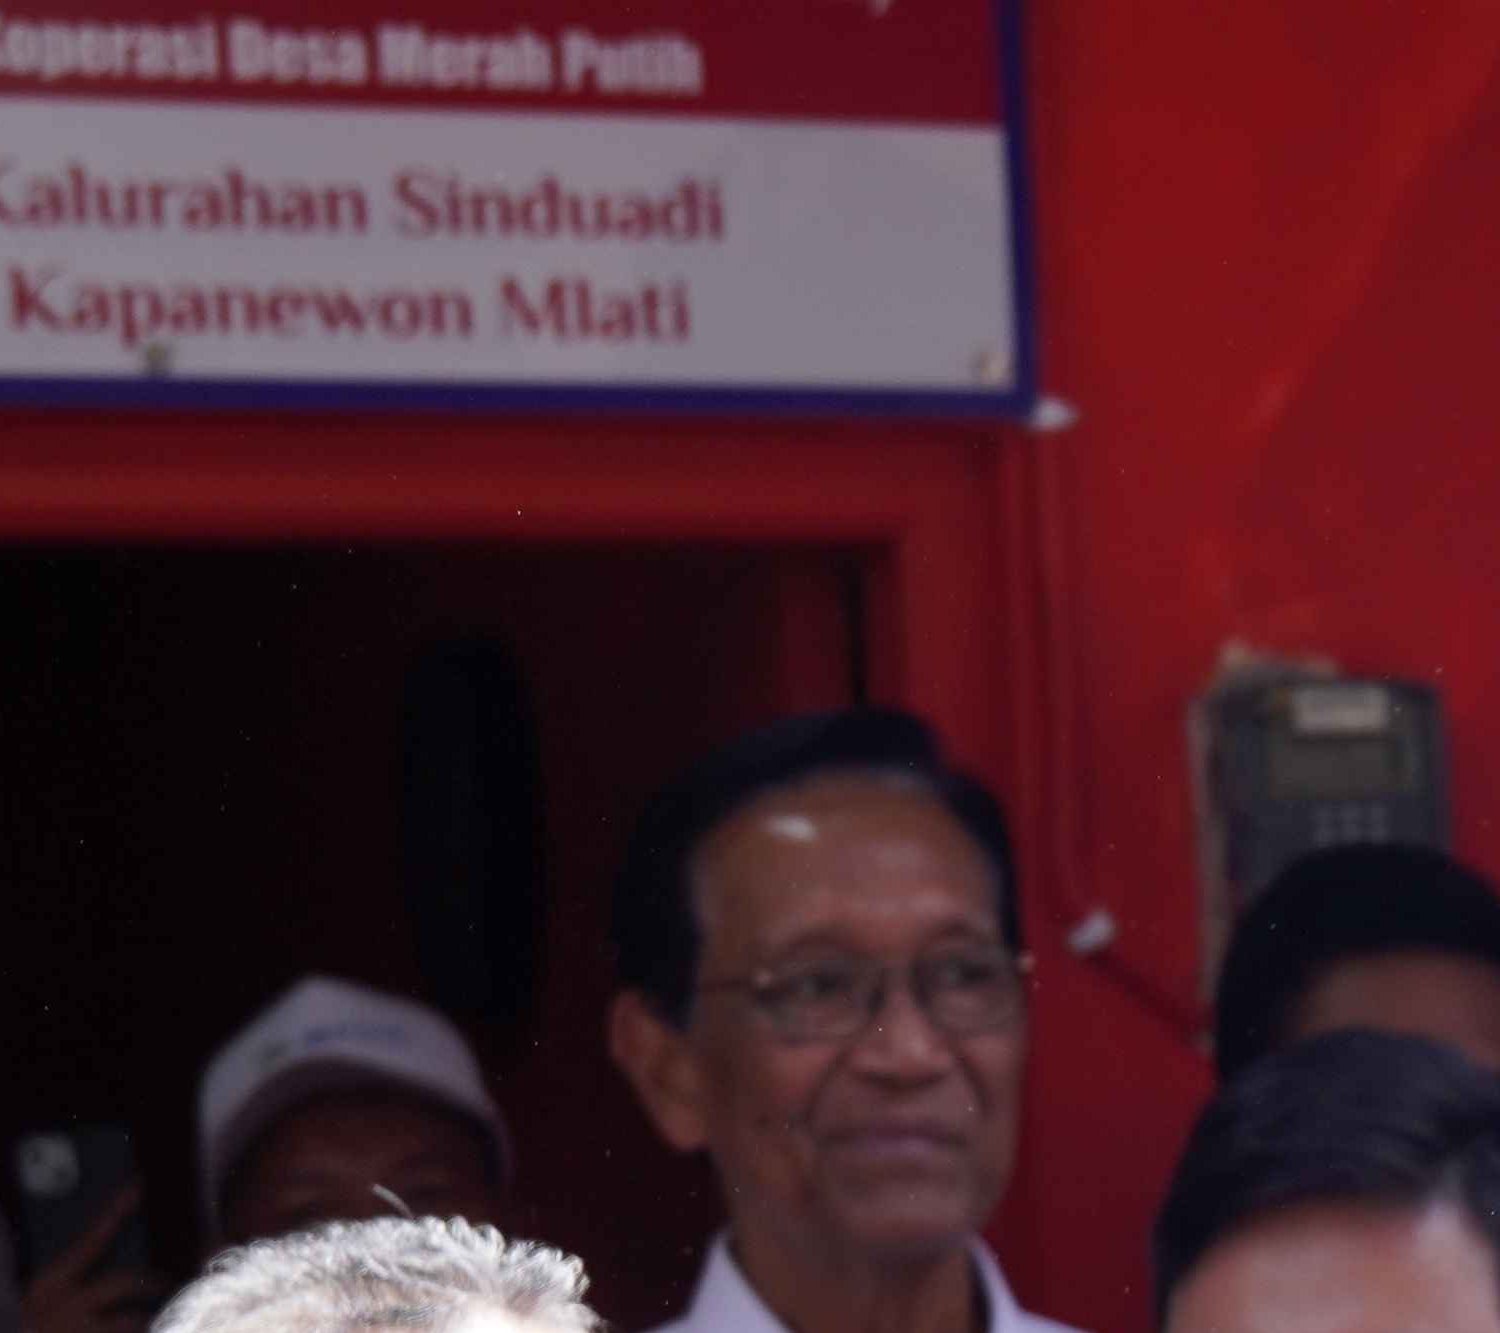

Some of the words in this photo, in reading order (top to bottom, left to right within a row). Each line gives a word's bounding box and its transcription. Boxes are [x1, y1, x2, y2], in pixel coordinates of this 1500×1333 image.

[230, 18, 366, 84] Desa
[380, 25, 551, 92] Merah
[562, 32, 704, 96] Putih
[393, 170, 725, 243] Sinduadi
[8, 265, 472, 346] Kapanewon
[500, 274, 690, 342] Mlati
